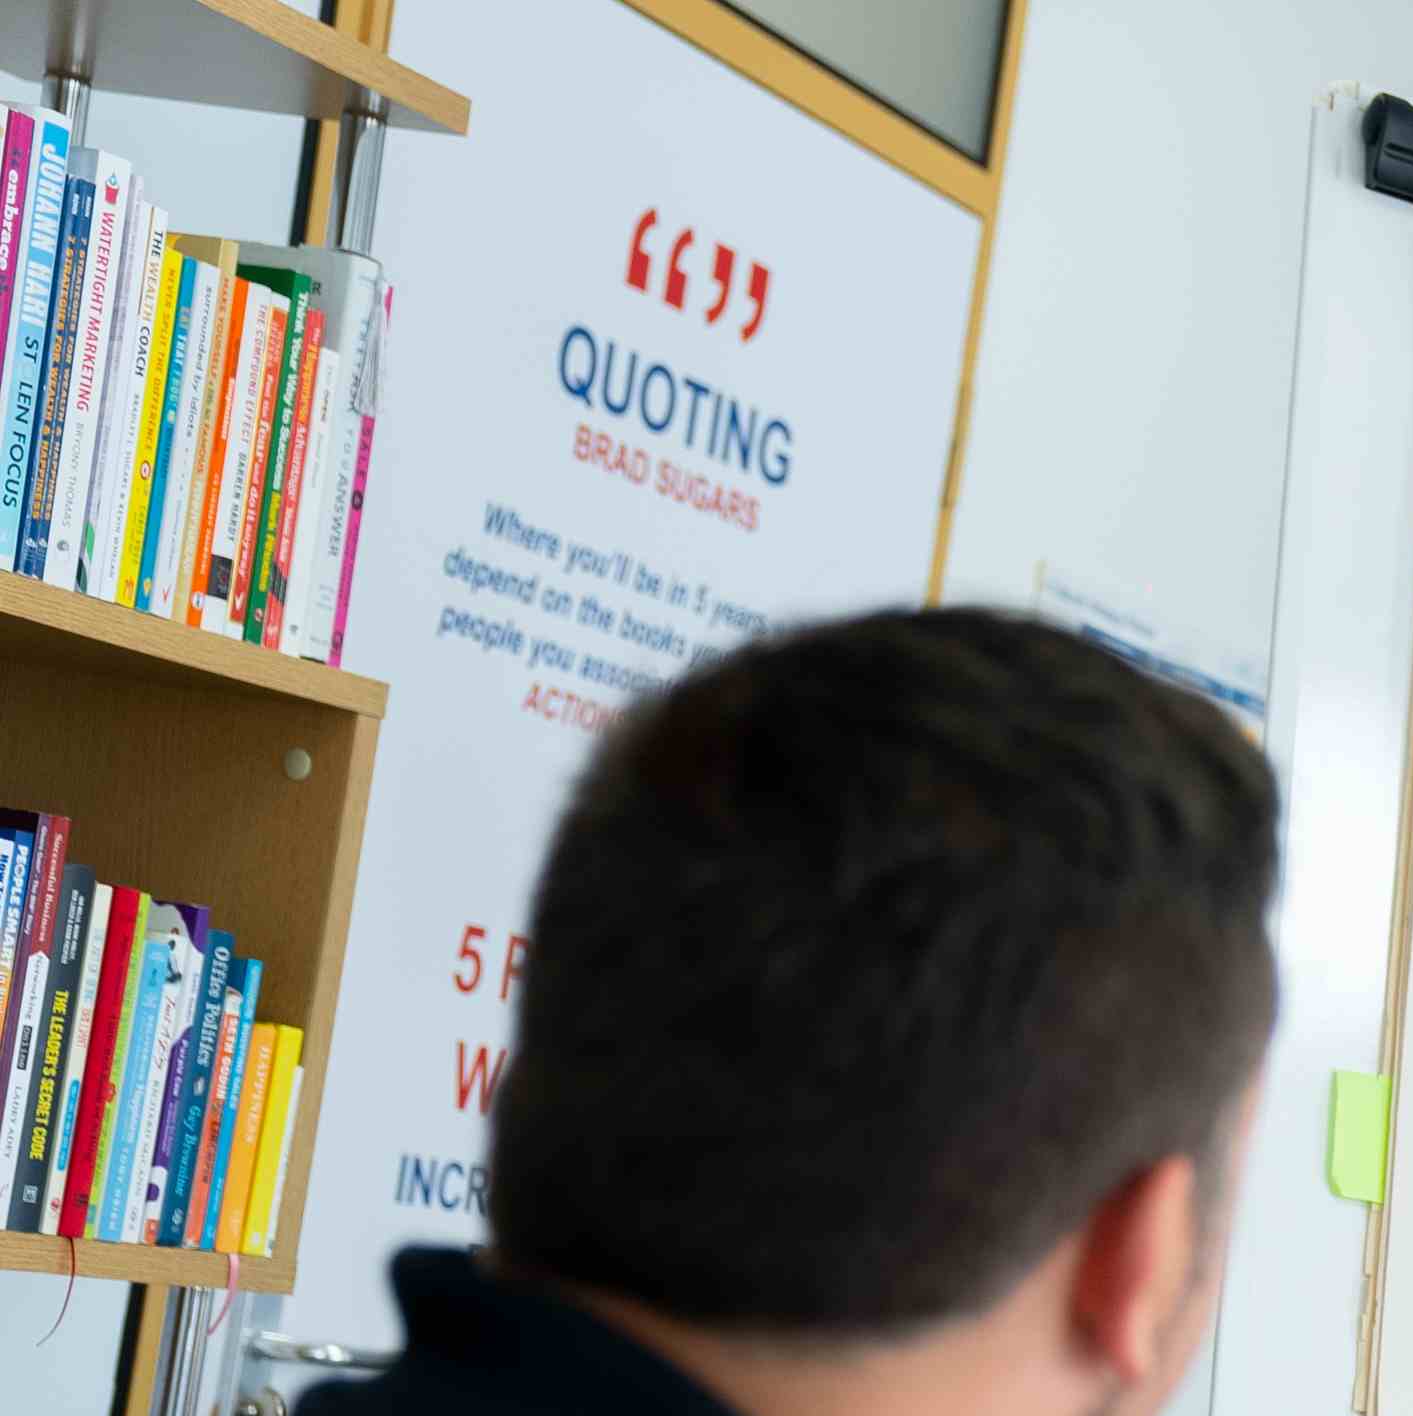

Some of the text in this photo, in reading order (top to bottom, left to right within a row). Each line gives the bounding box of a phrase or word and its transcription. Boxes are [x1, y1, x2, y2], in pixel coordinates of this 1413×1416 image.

[31, 144, 66, 251] JOHANN
[22, 262, 52, 324] HARI
[135, 230, 163, 376] THE WEALTH COACH
[257, 304, 267, 325] THE
[294, 291, 308, 334] Think
[52, 336, 63, 362] FOR
[145, 268, 176, 450] NEVER SPLIT THE DIFFERENCE
[175, 335, 186, 365] THAT
[195, 285, 212, 371] surrounded
[289, 338, 302, 371] Your
[45, 367, 58, 420] WEALTH
[57, 369, 71, 421] WEALTH
[61, 212, 115, 528] WATERTIGHT MARKETING BRYONY THOMAS
[248, 329, 264, 396] COMPOUND
[283, 375, 298, 405] Way
[241, 400, 253, 444] EFFECT
[282, 408, 293, 425] to
[558, 325, 795, 486] QUOTING
[3, 432, 25, 508] FOCUS
[32, 441, 48, 519] HAPPINESS
[44, 442, 60, 521] HAPPINESS
[273, 426, 290, 490] Success
[572, 423, 761, 531] BRAD SUGARS
[248, 487, 258, 507] do
[328, 473, 348, 558] ANSWER
[484, 503, 562, 561] Where
[634, 558, 662, 596] be
[668, 579, 689, 610] in
[694, 585, 711, 617] 5
[443, 546, 686, 658] depend on the books
[436, 604, 575, 672] people you
[10, 844, 29, 905] PEOPLE
[46, 833, 63, 891] Successful
[2, 907, 18, 968] SMART
[39, 894, 54, 942] Business
[452, 923, 486, 995] 5
[29, 991, 69, 1161] THE LEADER'S SECRET CODE
[175, 946, 230, 1197] Office Politics Guy Browning
[394, 1153, 490, 1216] INCR
